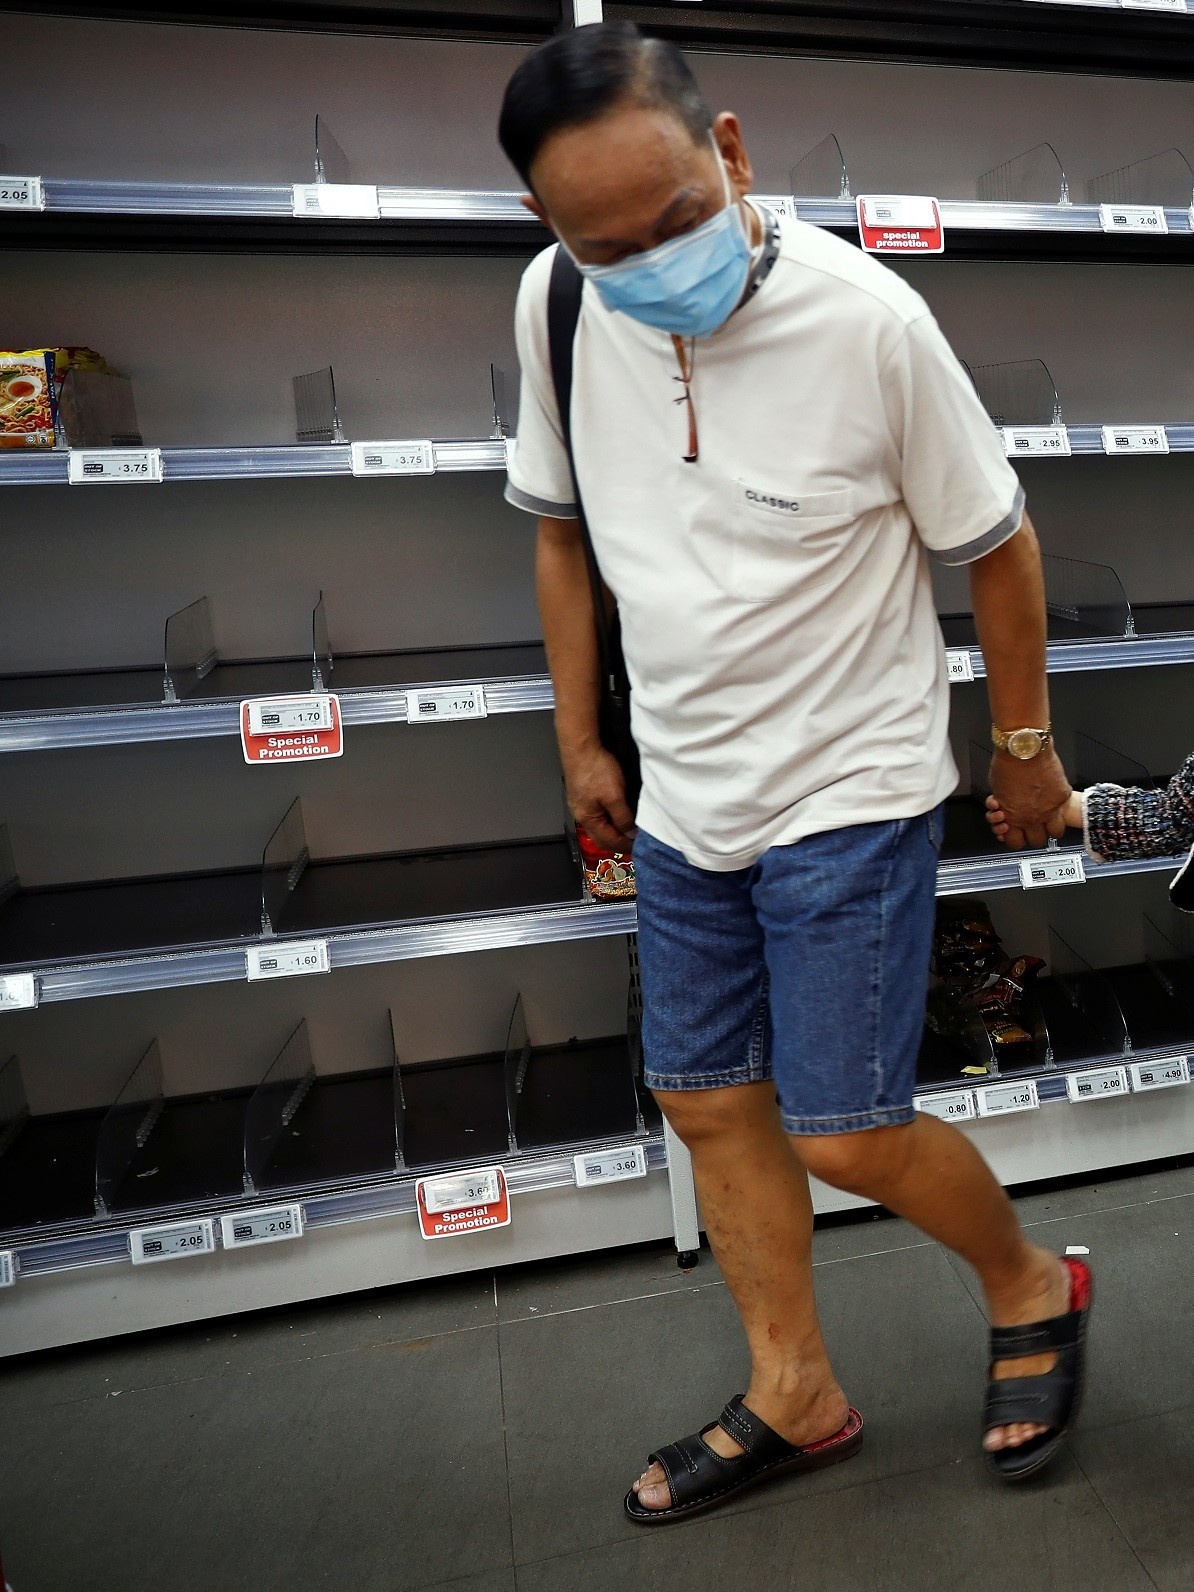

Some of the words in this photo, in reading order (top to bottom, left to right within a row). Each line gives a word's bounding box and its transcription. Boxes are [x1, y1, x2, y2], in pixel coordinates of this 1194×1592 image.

[1, 191, 28, 200] 2.05
[882, 231, 920, 240] special
[876, 239, 929, 248] promotion
[400, 456, 422, 464] 3.75
[123, 464, 148, 472] 3.75
[745, 490, 799, 511] CLASSIC
[453, 700, 474, 709] 1.70
[298, 712, 320, 721] 1.70
[268, 734, 318, 747] Special
[259, 745, 329, 758] Promotion
[1058, 868, 1075, 876] 2.00
[295, 956, 317, 966] 1.60
[1165, 1070, 1181, 1078] 4.90
[1103, 1080, 1119, 1089] 2.00
[1013, 1094, 1030, 1103] 1.20
[948, 1104, 966, 1113] 0.80
[616, 1161, 636, 1170] 3.60
[442, 1206, 488, 1222] Special
[270, 1221, 291, 1231] 2.05
[434, 1216, 498, 1234] Promotion
[180, 1236, 203, 1247] 2.05
